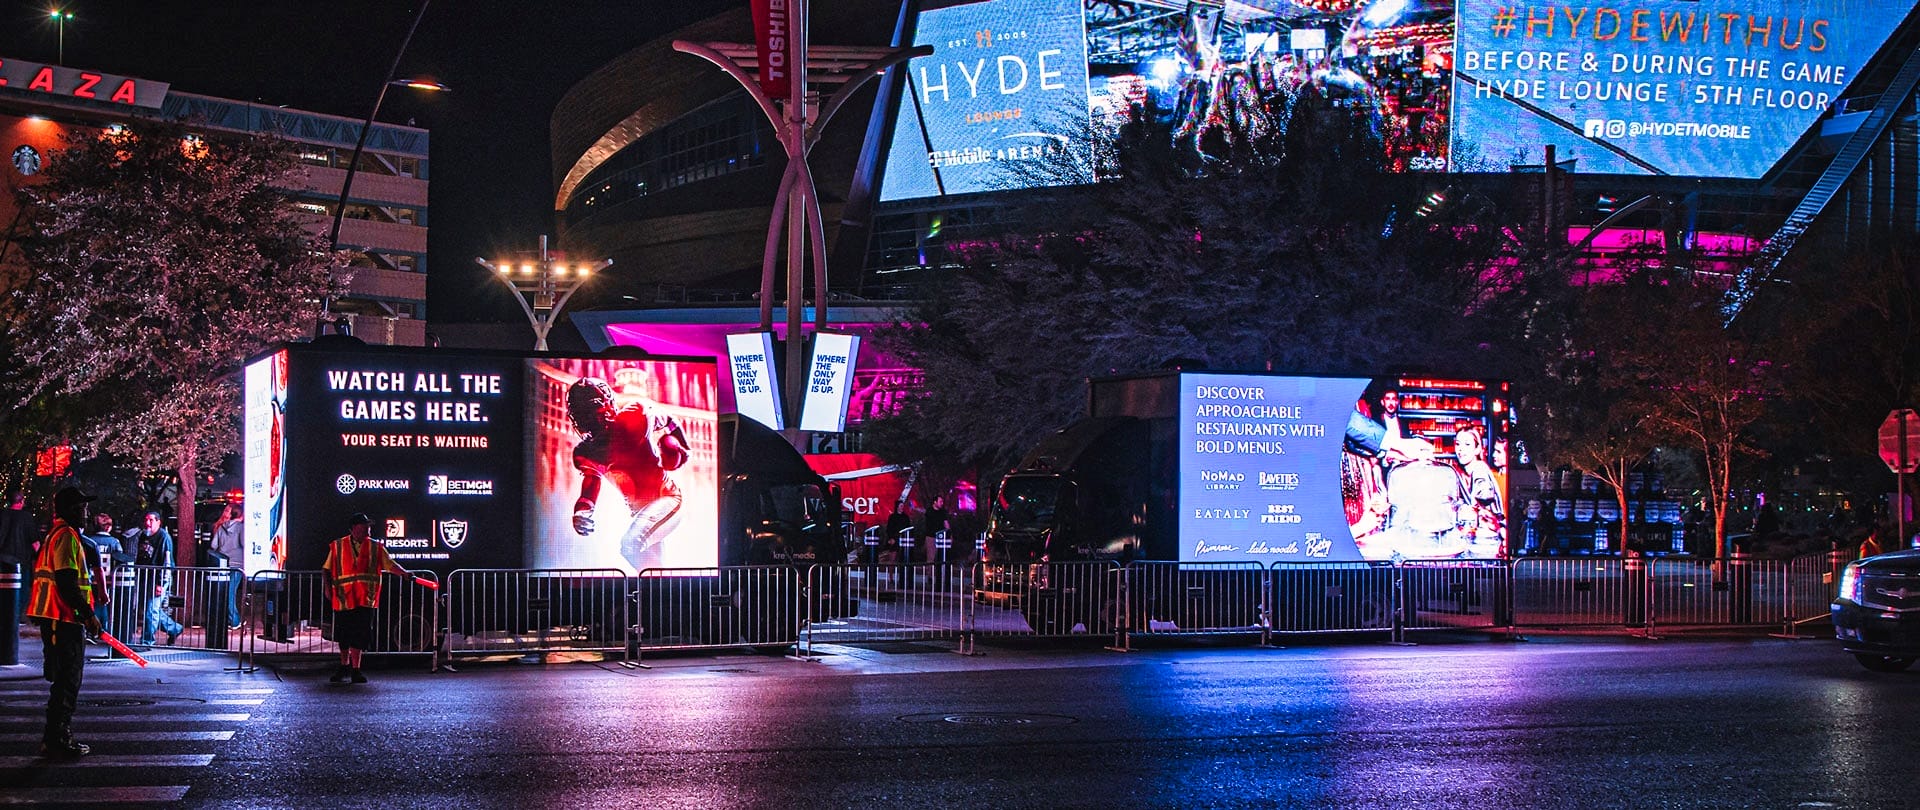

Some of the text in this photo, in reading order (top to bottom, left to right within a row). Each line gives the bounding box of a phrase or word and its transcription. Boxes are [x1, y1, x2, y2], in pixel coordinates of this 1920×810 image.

[1490, 6, 1829, 51] #HYDEWITHUS
[948, 30, 1027, 48] EST. 2005
[1465, 51, 1846, 85] BEFORE & DURING THE GAME
[920, 49, 1065, 104] HYDE
[1475, 79, 1828, 111] HYDE LOUNGE 5TH FLOOR
[1629, 121, 1751, 139] @HYDETMOBILE
[734, 354, 764, 363] WHERE
[817, 354, 847, 364] WHERE
[735, 362, 752, 370] THE
[816, 362, 832, 371] THE
[736, 370, 758, 378] ONLY
[814, 370, 836, 378] ONLY
[328, 371, 501, 394] WATCH ALL THE
[737, 378, 756, 386] WAY
[813, 378, 832, 386] WAY
[739, 386, 747, 394] IS
[811, 385, 834, 394] IS UP.
[1196, 385, 1265, 400] DISCOVER
[341, 400, 489, 422] GAMES HERE.
[1196, 404, 1302, 419] APPROACHABLE
[1196, 422, 1325, 437] RESTAURANTS WITH
[342, 434, 488, 449] YOUR SEAT IS WAITING
[1196, 441, 1286, 455] BOLD MENUS.
[358, 479, 410, 489] PARK MGM
[448, 480, 493, 490] BETMGM
[1195, 509, 1250, 519] EATALY
[1268, 504, 1295, 514] BEST
[1261, 515, 1302, 523] FRIEND
[386, 539, 428, 548] RESORTS
[1246, 541, 1269, 554] lala
